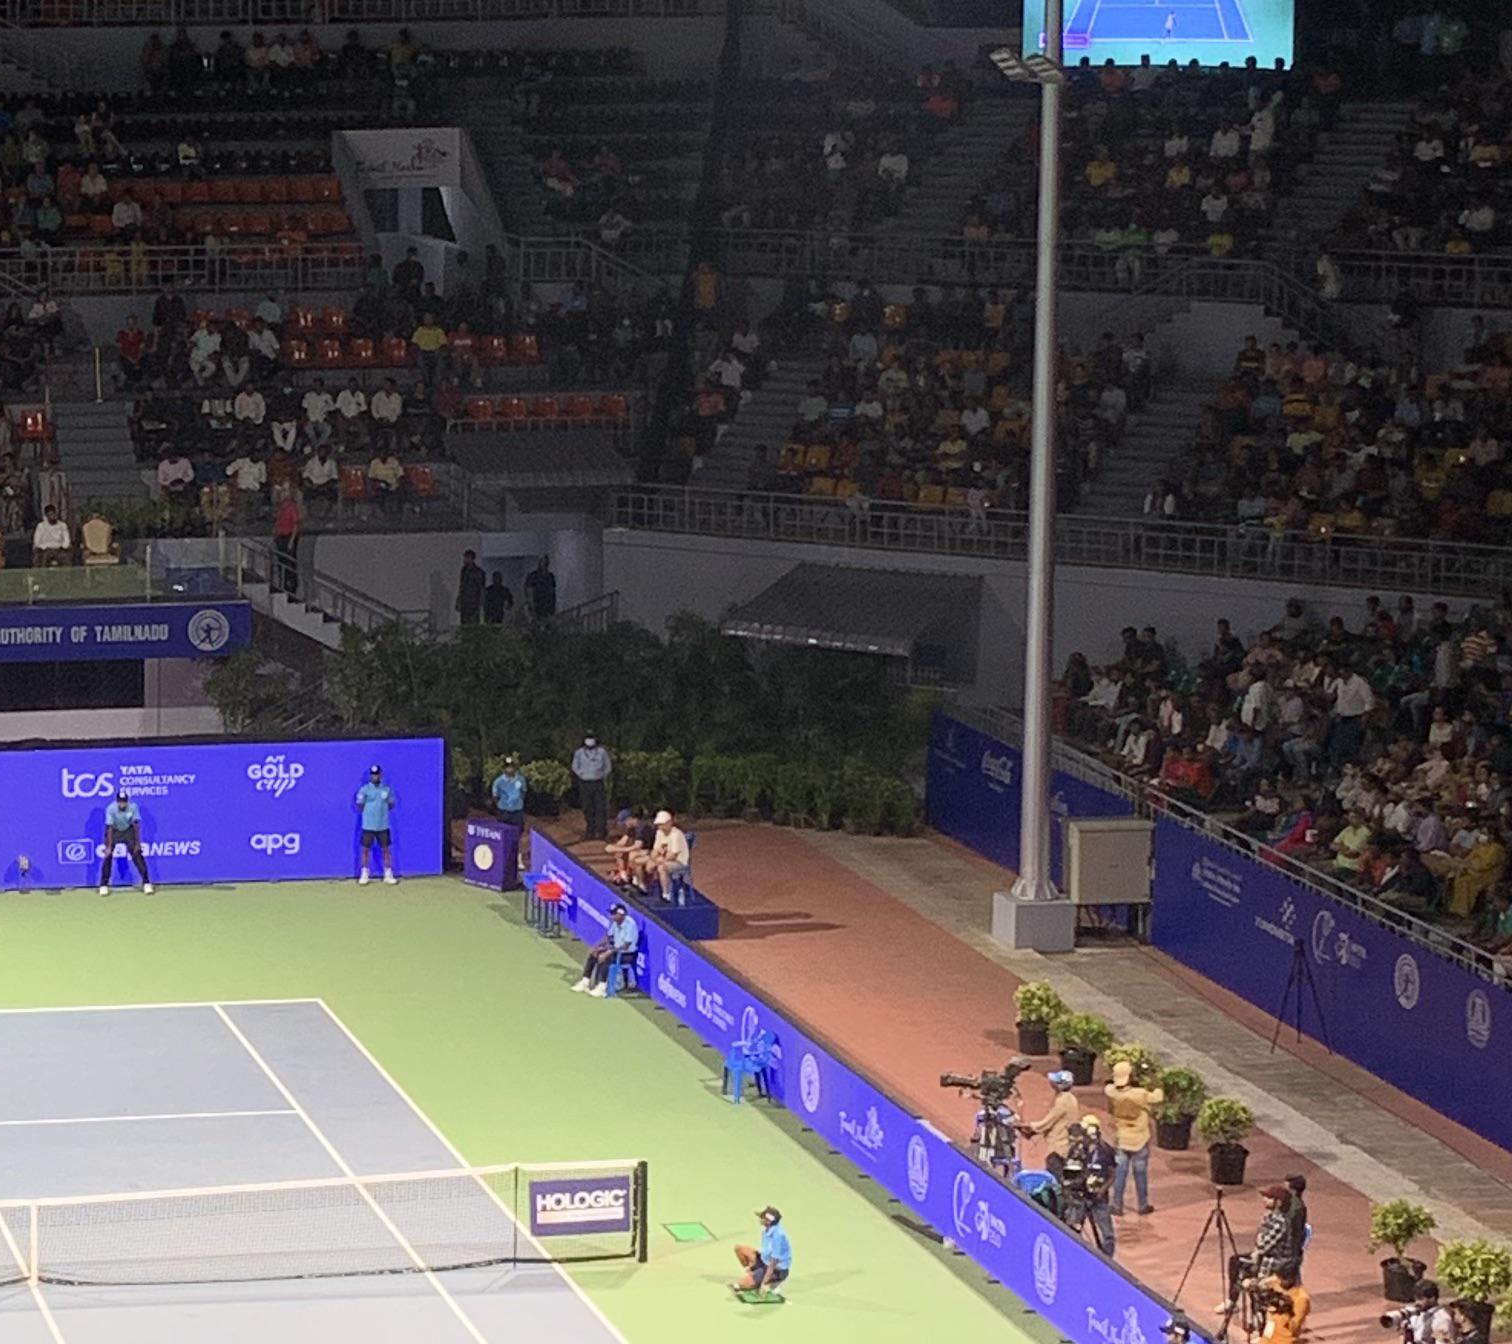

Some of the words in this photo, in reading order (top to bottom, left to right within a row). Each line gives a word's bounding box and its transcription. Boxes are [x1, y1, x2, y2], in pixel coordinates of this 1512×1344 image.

[70, 625, 88, 643] OF
[94, 623, 169, 642] TAMILNADU
[120, 765, 152, 775] TATA
[120, 774, 196, 786] CONSULTANCY
[247, 763, 305, 780] GOLD
[61, 767, 115, 798] tcs
[256, 778, 297, 798] cup
[250, 832, 301, 855] apg
[536, 1188, 627, 1211] HOLOGIC
